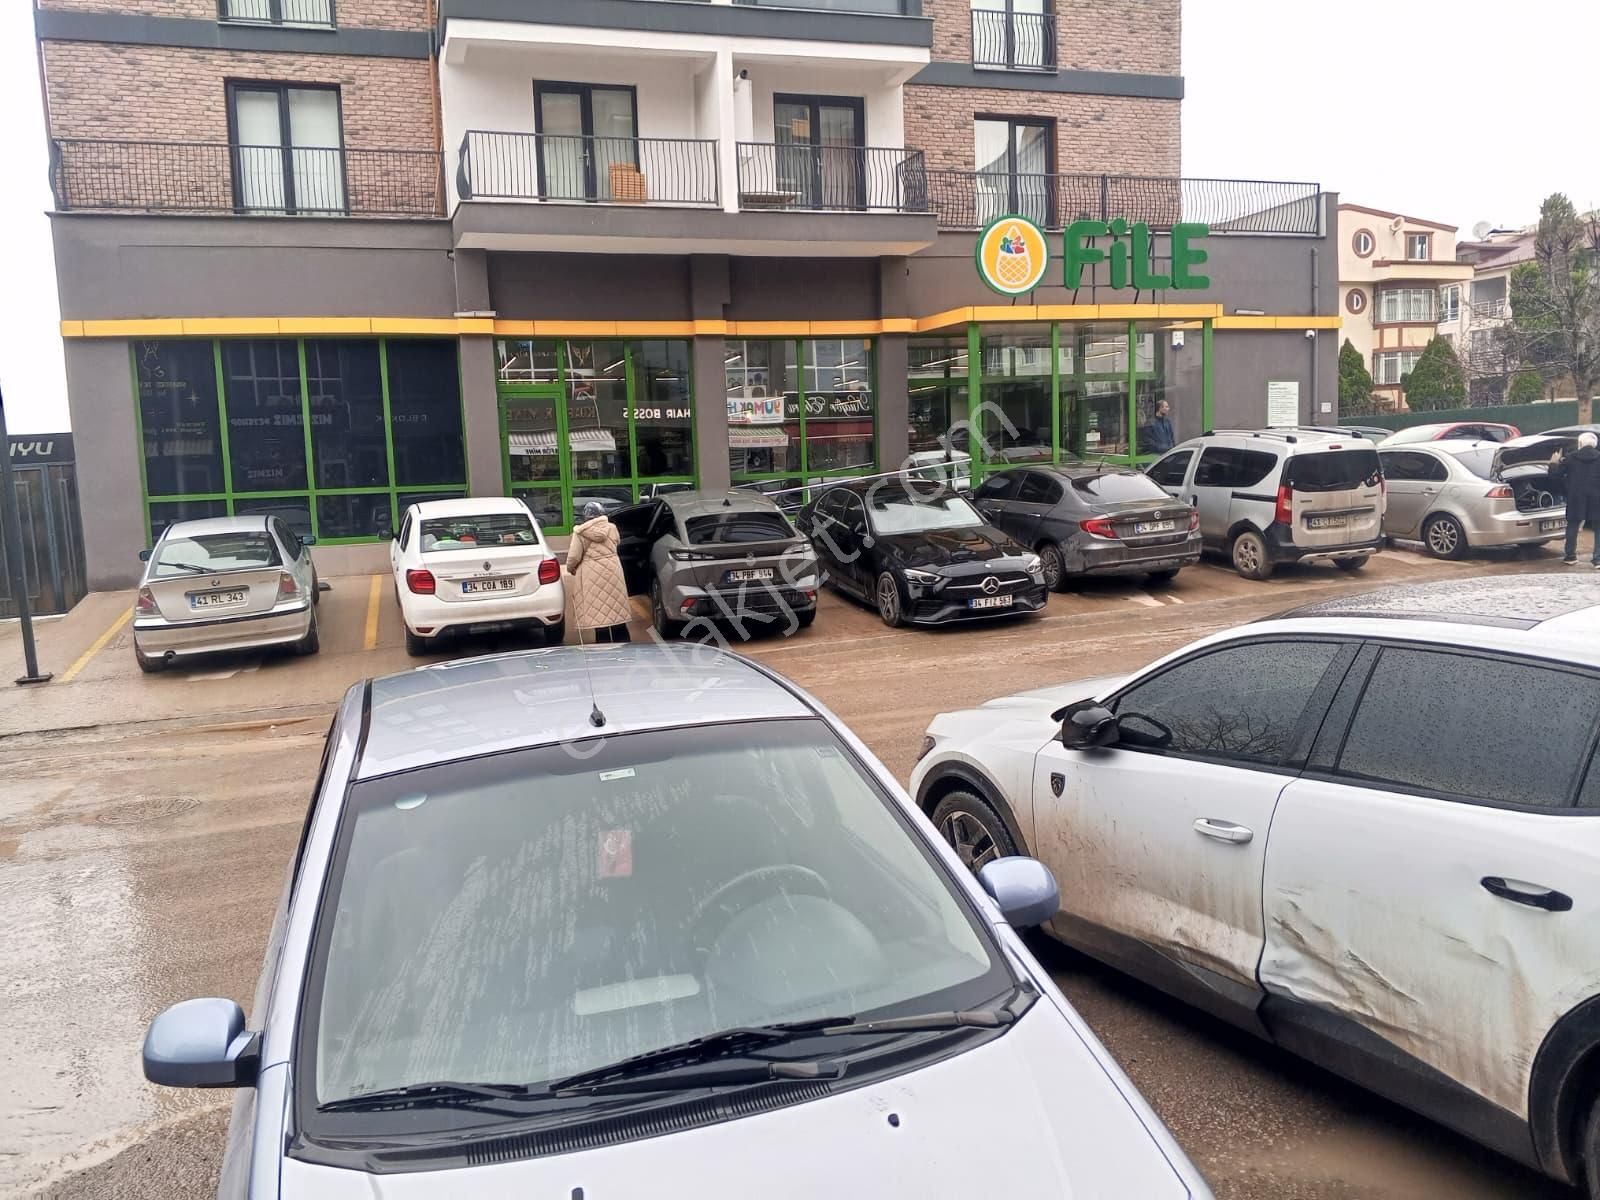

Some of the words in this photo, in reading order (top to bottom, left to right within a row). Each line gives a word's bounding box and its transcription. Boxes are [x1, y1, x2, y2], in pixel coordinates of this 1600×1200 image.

[467, 583, 478, 592] 34
[196, 596, 209, 605] 41
[211, 594, 224, 604] RL
[226, 591, 244, 602] 343
